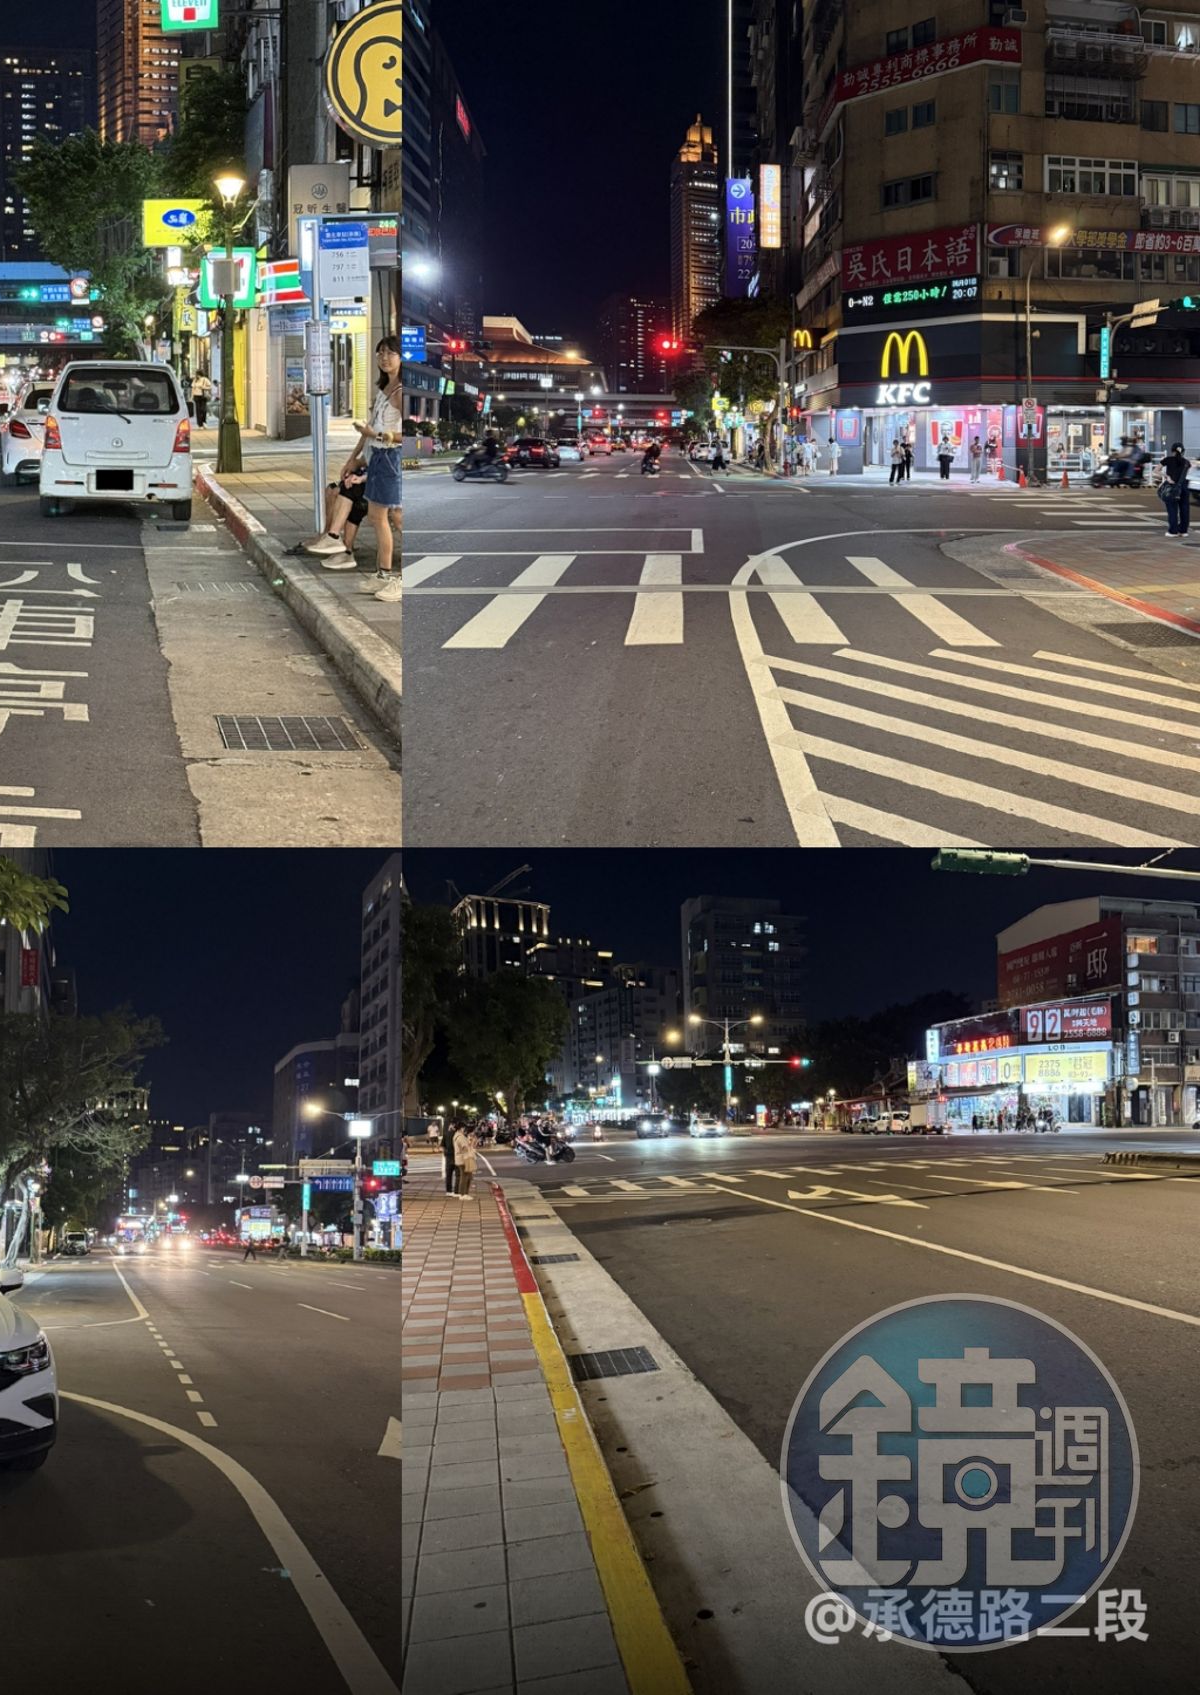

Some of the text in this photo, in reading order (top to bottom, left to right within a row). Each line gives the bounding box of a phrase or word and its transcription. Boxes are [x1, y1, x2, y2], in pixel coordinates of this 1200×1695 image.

[842, 32, 1018, 88] 勤誠專利商標事務所 勤誠
[857, 54, 960, 95] 2555-6666
[847, 236, 971, 282] 吳氏日本語
[952, 287, 978, 299] 20:07
[876, 382, 932, 404] KFC
[1029, 1011, 1059, 1039] 92
